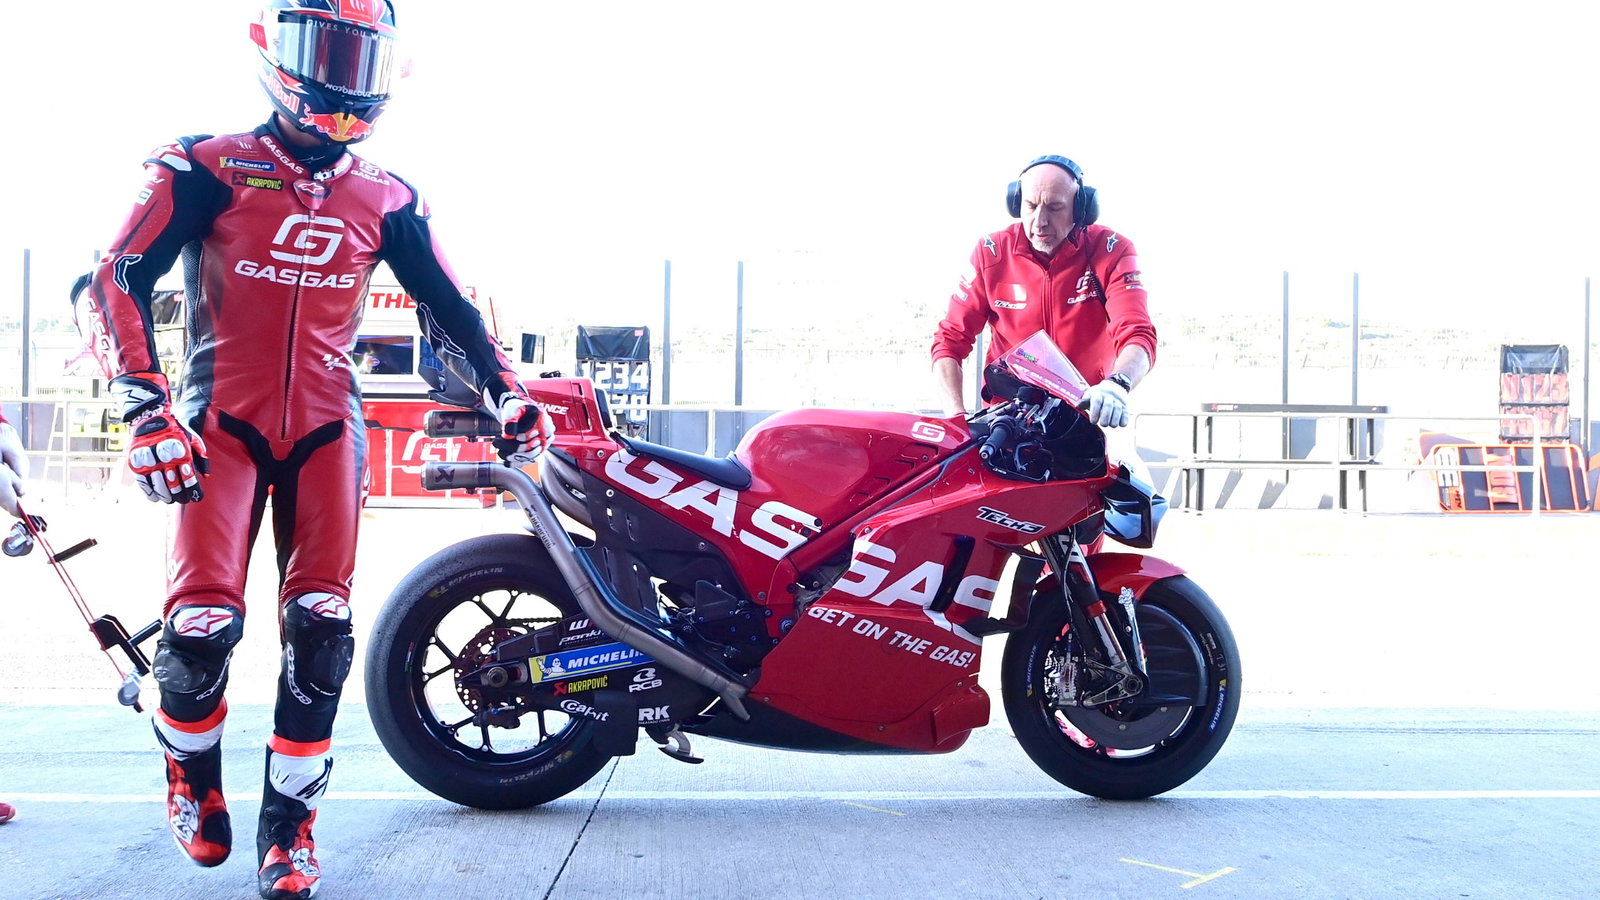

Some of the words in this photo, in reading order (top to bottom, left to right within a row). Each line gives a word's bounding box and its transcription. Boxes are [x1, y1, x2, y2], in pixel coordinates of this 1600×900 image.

[306, 19, 338, 32] GIVES
[345, 26, 366, 38] YOU
[235, 160, 271, 169] MICHELIN
[263, 137, 304, 174] GASGAS
[350, 169, 391, 186] GASGAS
[234, 259, 357, 289] GASGAS
[370, 293, 416, 308] THE
[605, 448, 822, 561] GAS
[808, 606, 855, 627] GET
[852, 618, 889, 640] ON
[889, 630, 933, 655] THE
[929, 645, 974, 669] GAS!
[628, 679, 663, 693] RCB
[638, 705, 671, 721] RK
[1210, 692, 1225, 730] MICHELIN
